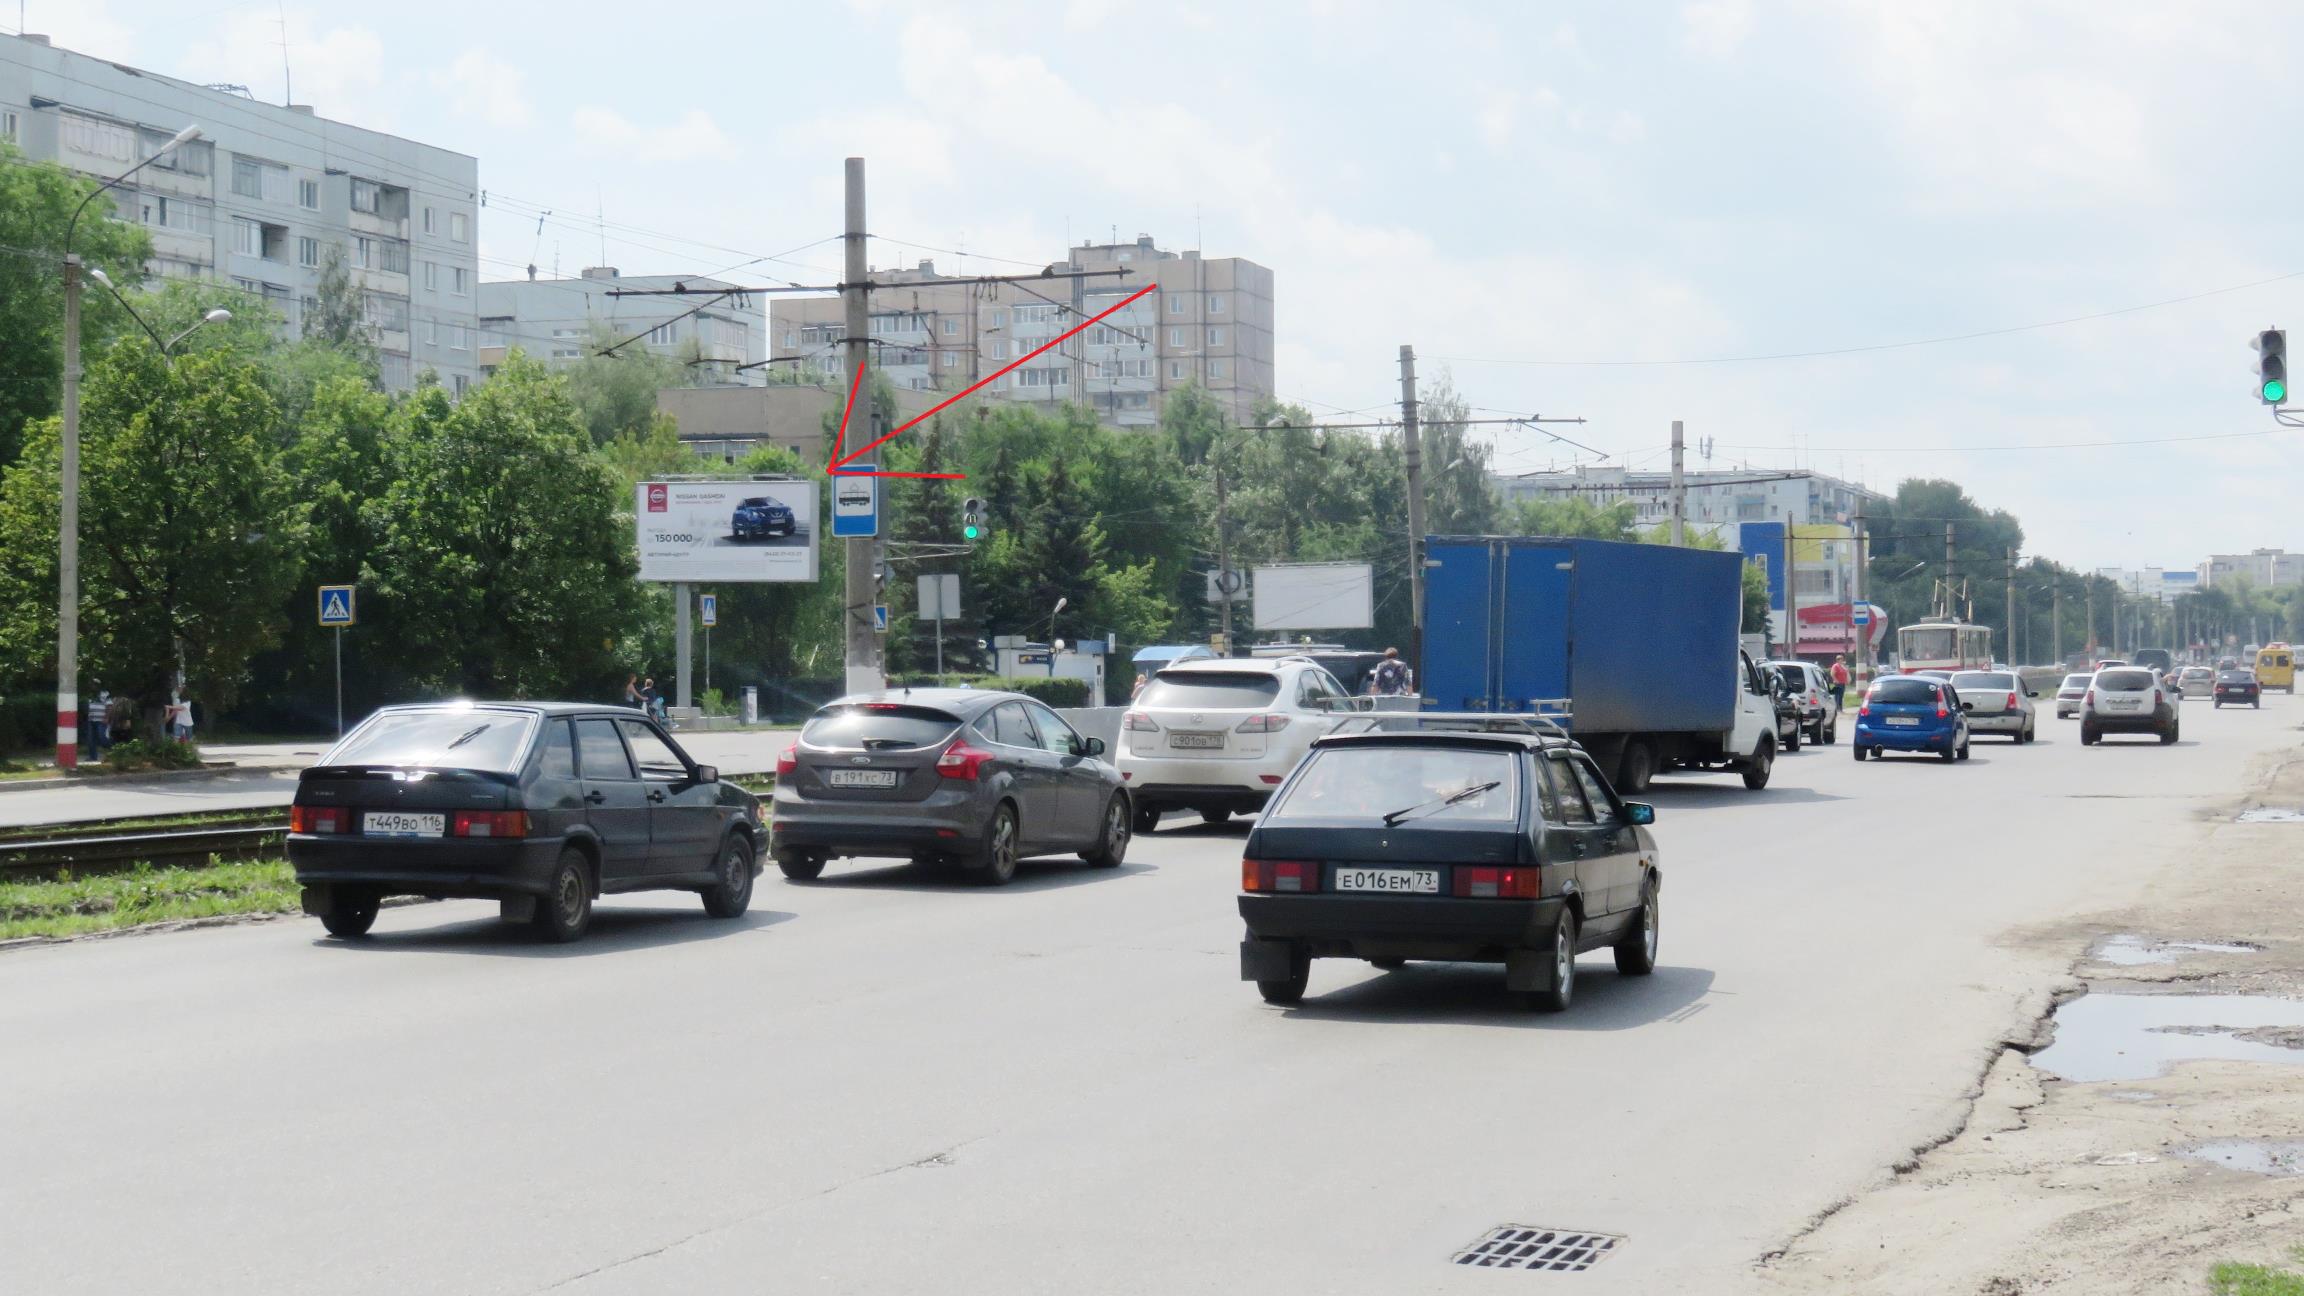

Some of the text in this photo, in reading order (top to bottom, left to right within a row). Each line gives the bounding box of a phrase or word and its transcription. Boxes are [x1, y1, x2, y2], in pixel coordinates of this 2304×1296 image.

[655, 534, 693, 543] 150 000
[369, 815, 441, 831] Т449ВО 116
[1343, 871, 1432, 889] Е016ЕМ 73
